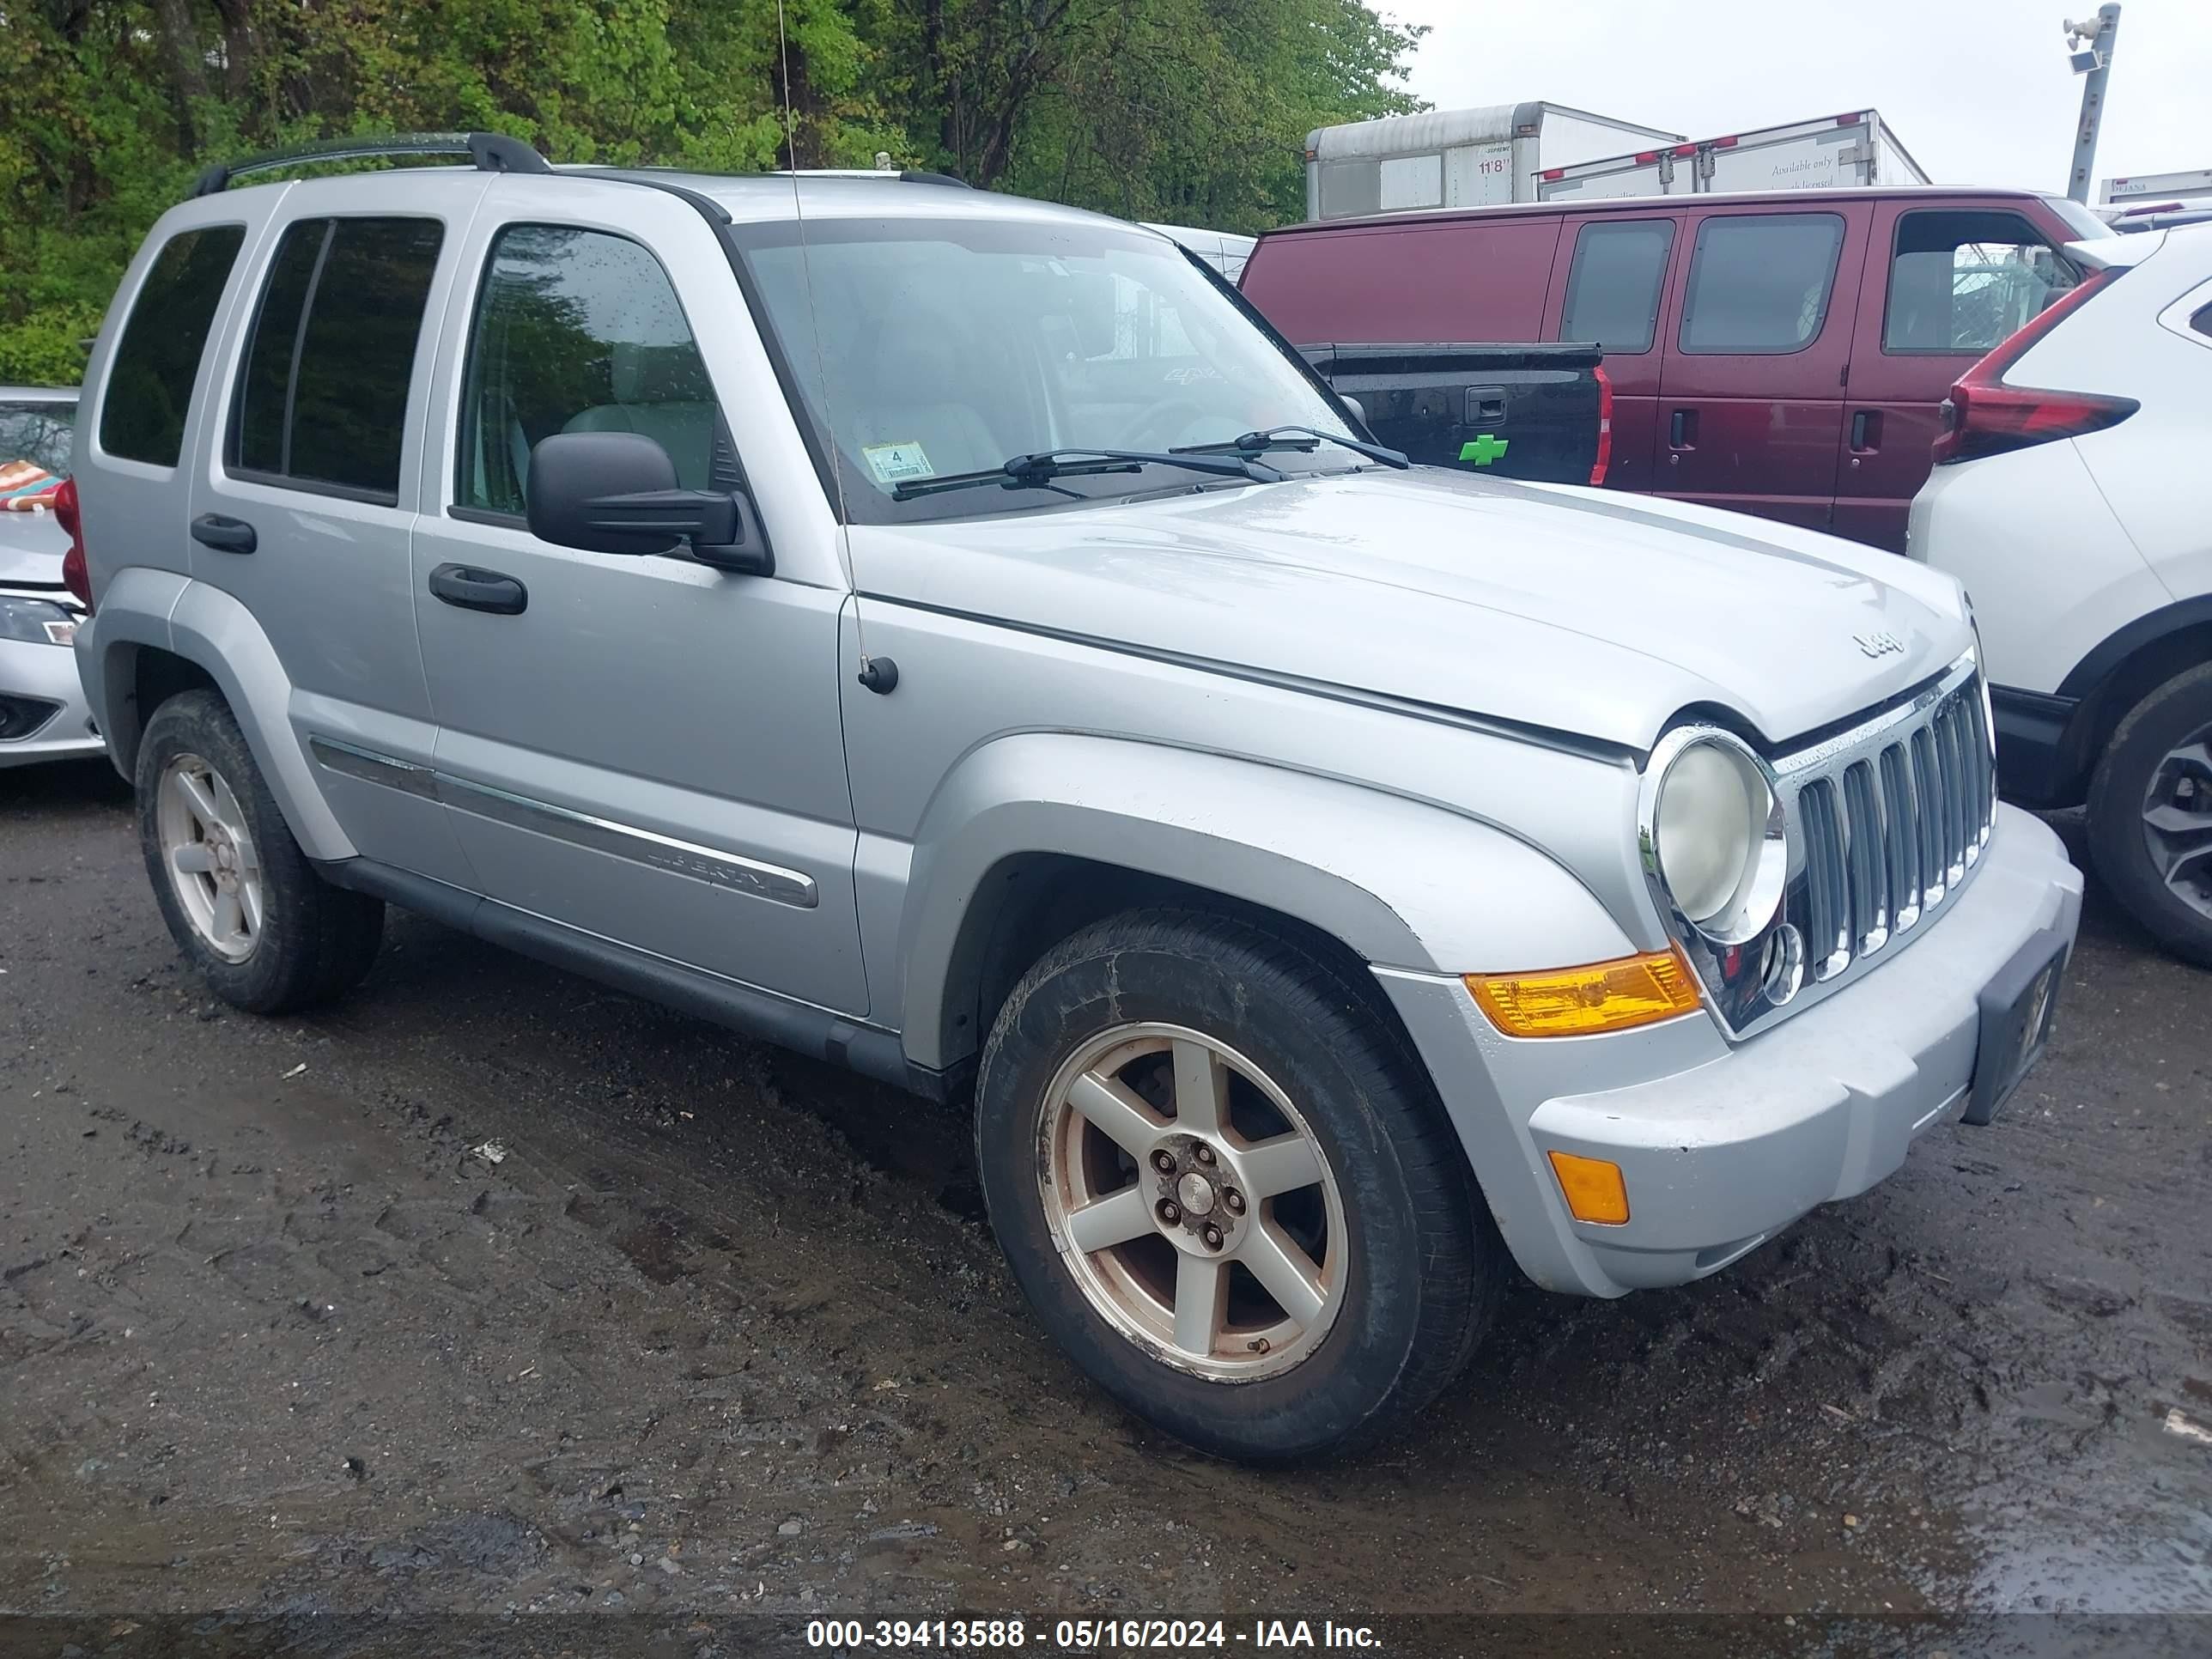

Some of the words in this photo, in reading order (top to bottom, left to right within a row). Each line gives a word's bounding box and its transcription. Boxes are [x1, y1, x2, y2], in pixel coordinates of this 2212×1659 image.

[1486, 145, 1510, 154] SUPREME
[1771, 160, 1811, 177] Available
[1814, 155, 1833, 171] only
[892, 451, 902, 462] 4
[1852, 631, 1905, 659] Jeep
